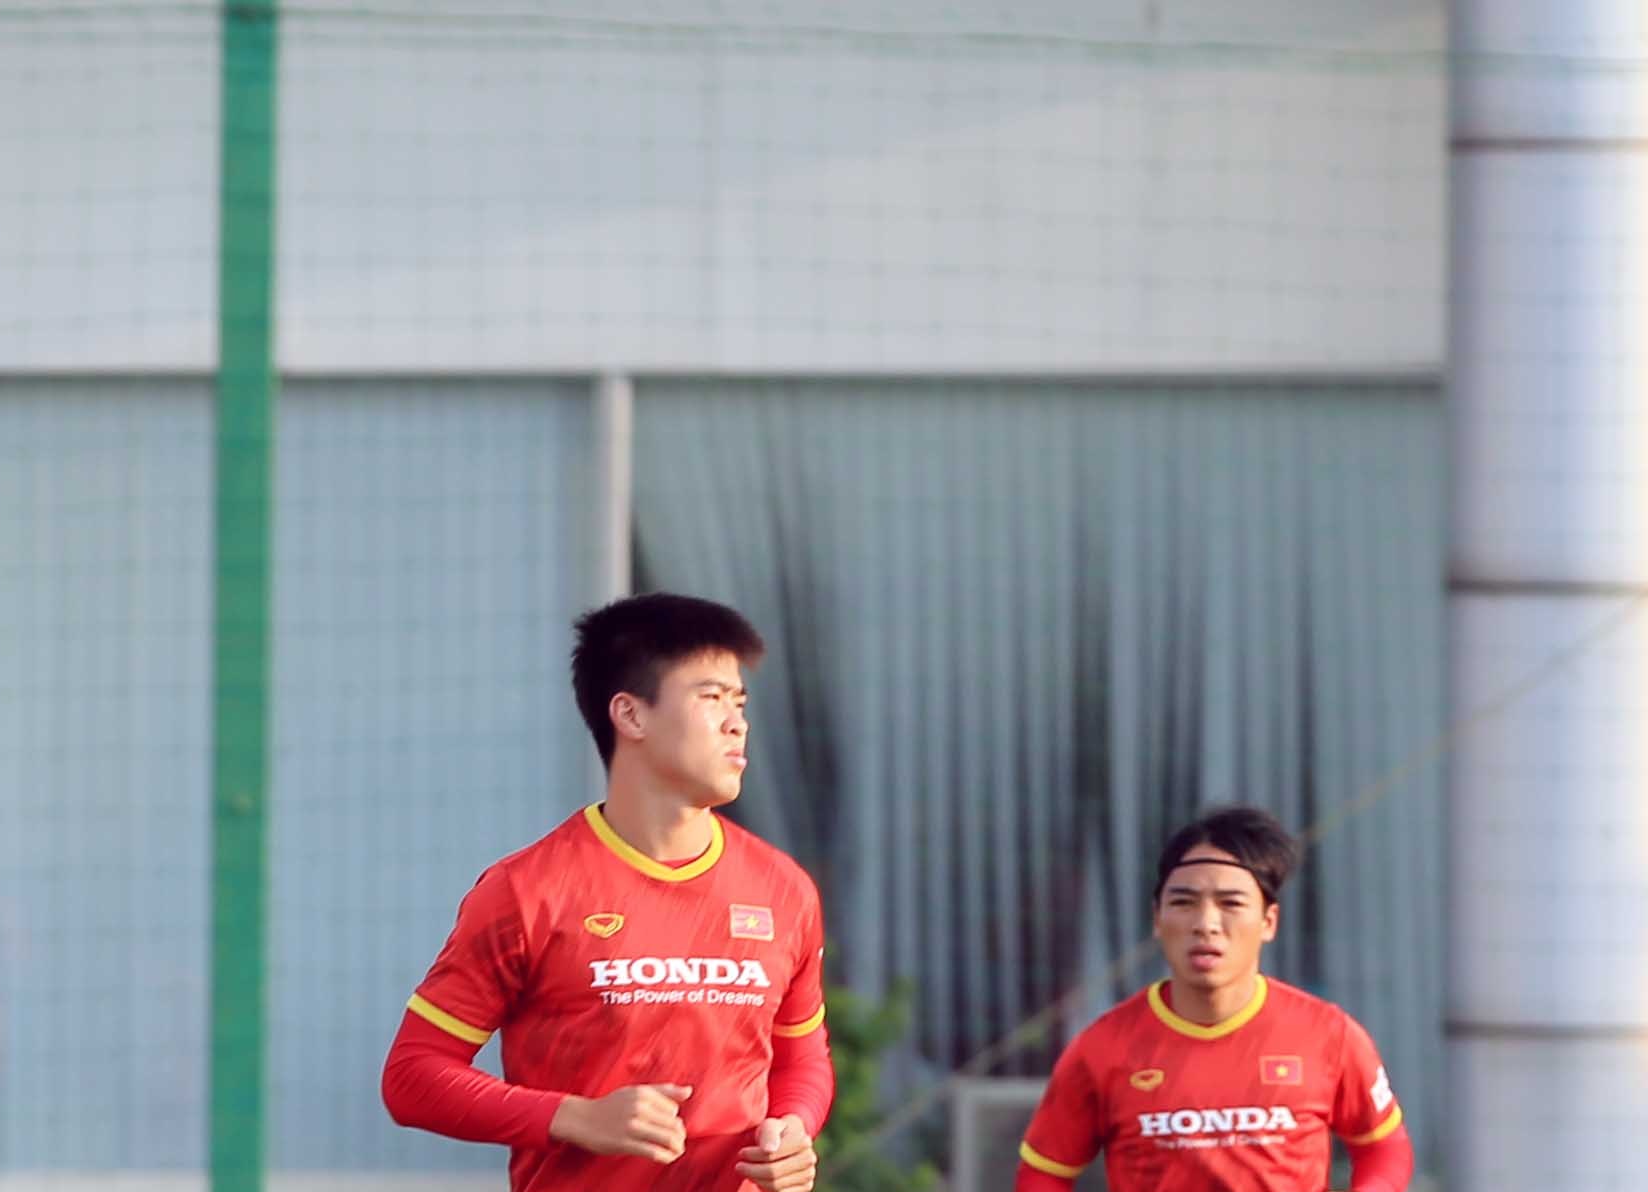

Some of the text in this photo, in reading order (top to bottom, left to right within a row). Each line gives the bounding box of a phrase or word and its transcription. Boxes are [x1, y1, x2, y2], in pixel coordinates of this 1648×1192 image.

[589, 957, 771, 987] HONDA
[600, 988, 766, 1006] The Power of Dreams
[1138, 1106, 1298, 1136] HONDA
